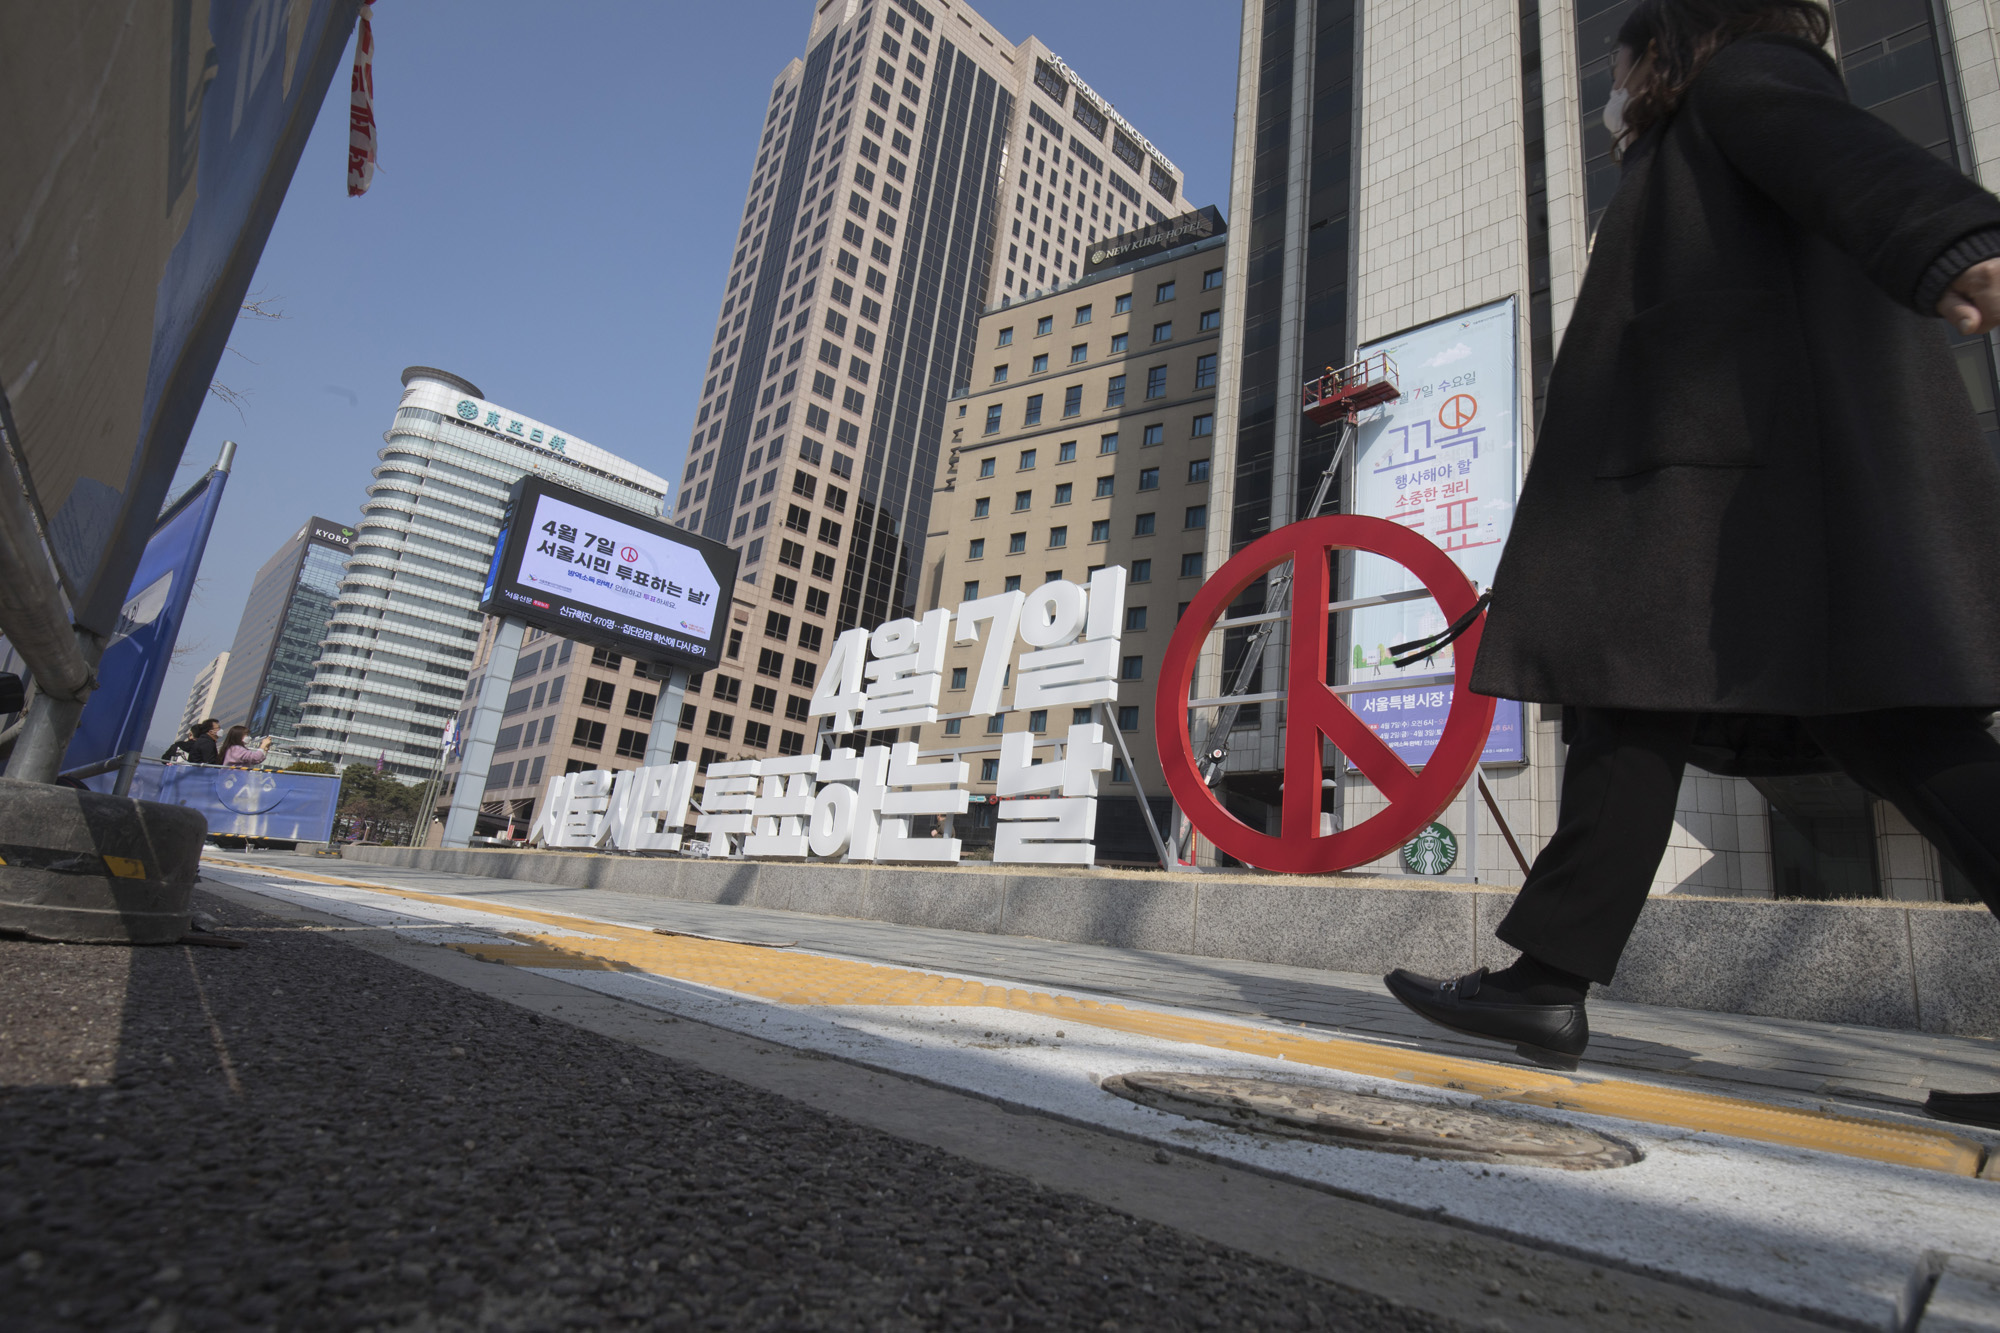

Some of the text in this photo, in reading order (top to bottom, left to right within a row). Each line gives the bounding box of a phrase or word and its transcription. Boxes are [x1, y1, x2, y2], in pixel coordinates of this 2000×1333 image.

[1069, 70, 1102, 107] SEOUL
[1103, 101, 1143, 144] FINANCE
[1143, 138, 1175, 173] CENTER
[1105, 221, 1203, 259] NEW KUKJE HOTEL
[1413, 384, 1433, 400] 7일
[1438, 371, 1476, 392] 수요일
[484, 411, 567, 454] 東亞日報
[1395, 458, 1472, 490] 행사해야 할
[1394, 479, 1469, 508] 소중한 권리
[315, 528, 349, 545] KYOBO
[541, 520, 616, 557] 4월 7일
[536, 539, 710, 606] 서울시민 투표하는 날!
[614, 584, 642, 598] 안심하고
[505, 591, 533, 605] 서울신문
[559, 605, 593, 623] 신규확진
[653, 632, 676, 648] 확산에
[676, 640, 691, 652] 다시
[691, 644, 706, 656] 증가
[809, 565, 1127, 733] 4월 7일
[1362, 691, 1445, 713] 서울특별시장
[530, 722, 1114, 865] 서울시민 투표하는 날
